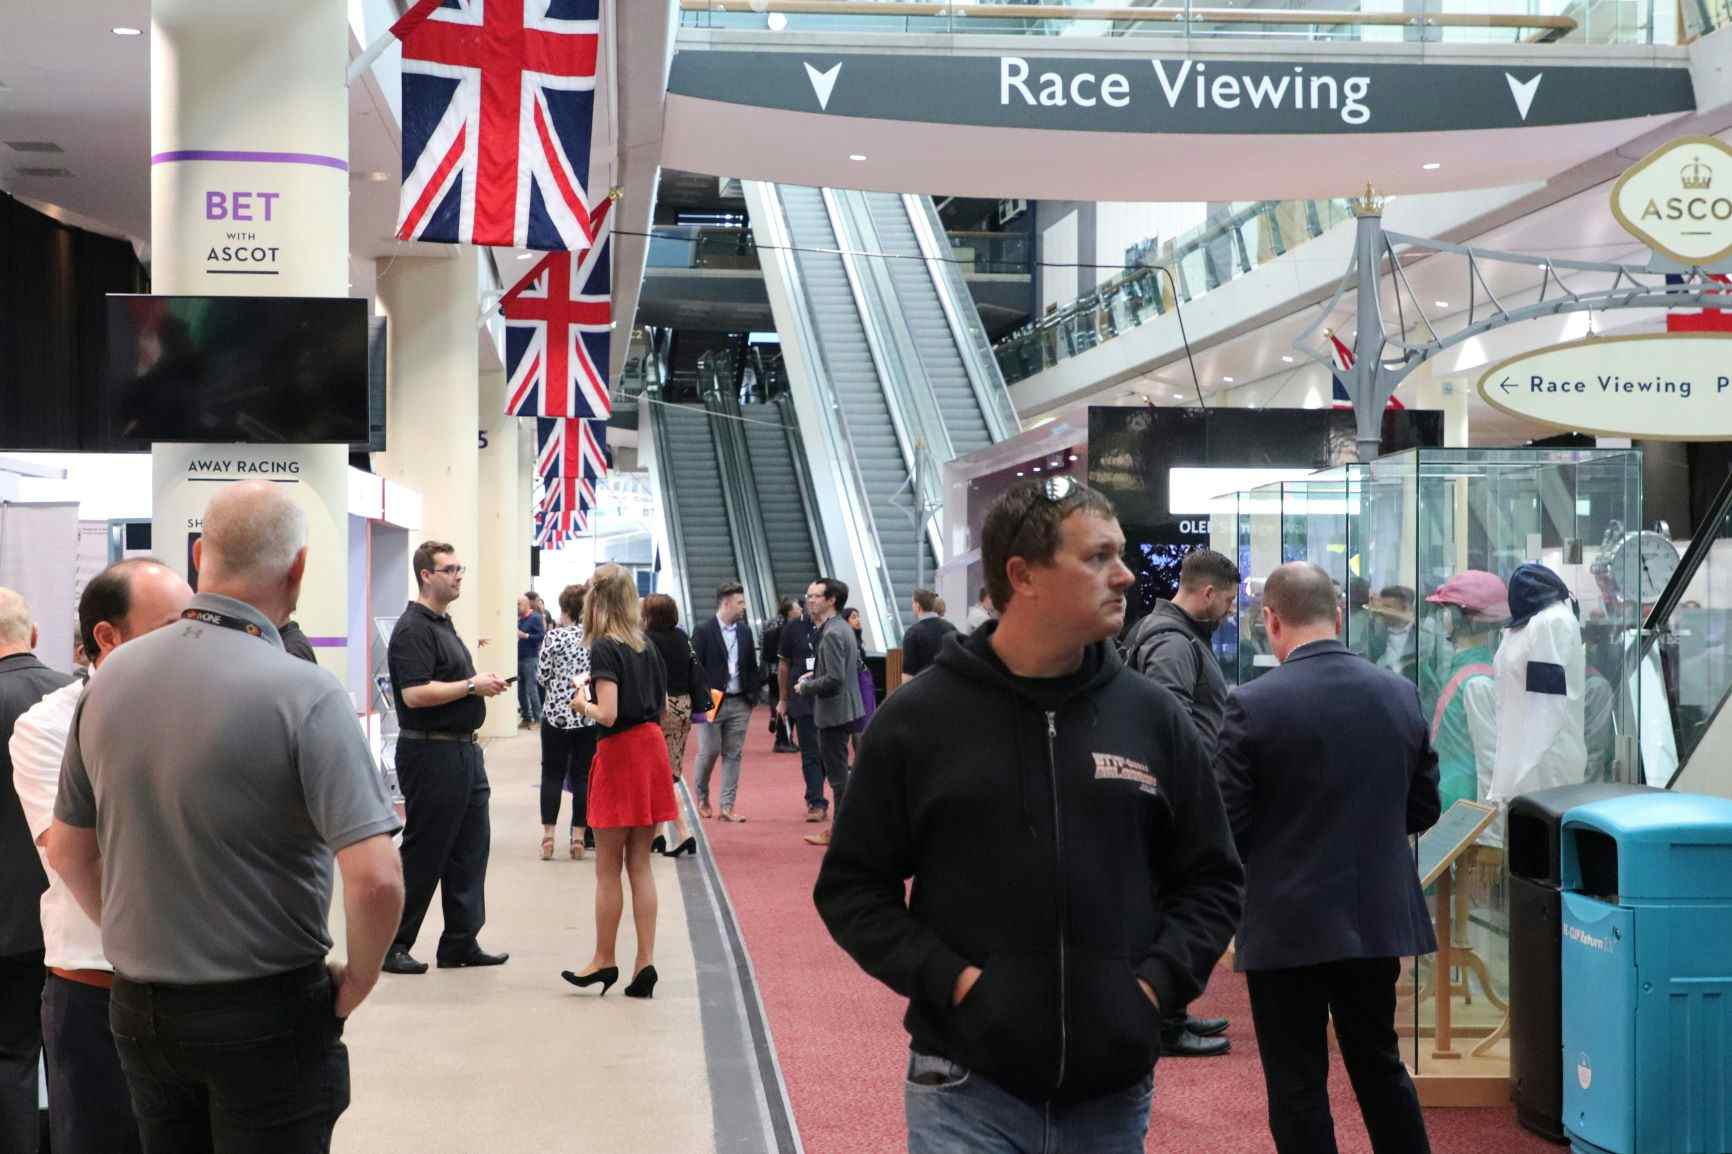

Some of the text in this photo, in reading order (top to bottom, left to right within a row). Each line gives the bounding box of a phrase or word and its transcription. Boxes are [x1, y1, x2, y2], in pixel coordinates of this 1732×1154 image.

[1000, 56, 1371, 125] Race Viewing
[206, 191, 280, 221] BET
[225, 231, 256, 240] WITH
[207, 246, 280, 262] ASCOT
[1530, 376, 1586, 393] Race
[1598, 375, 1692, 398] Viewing
[188, 460, 300, 473] AWAY RACING
